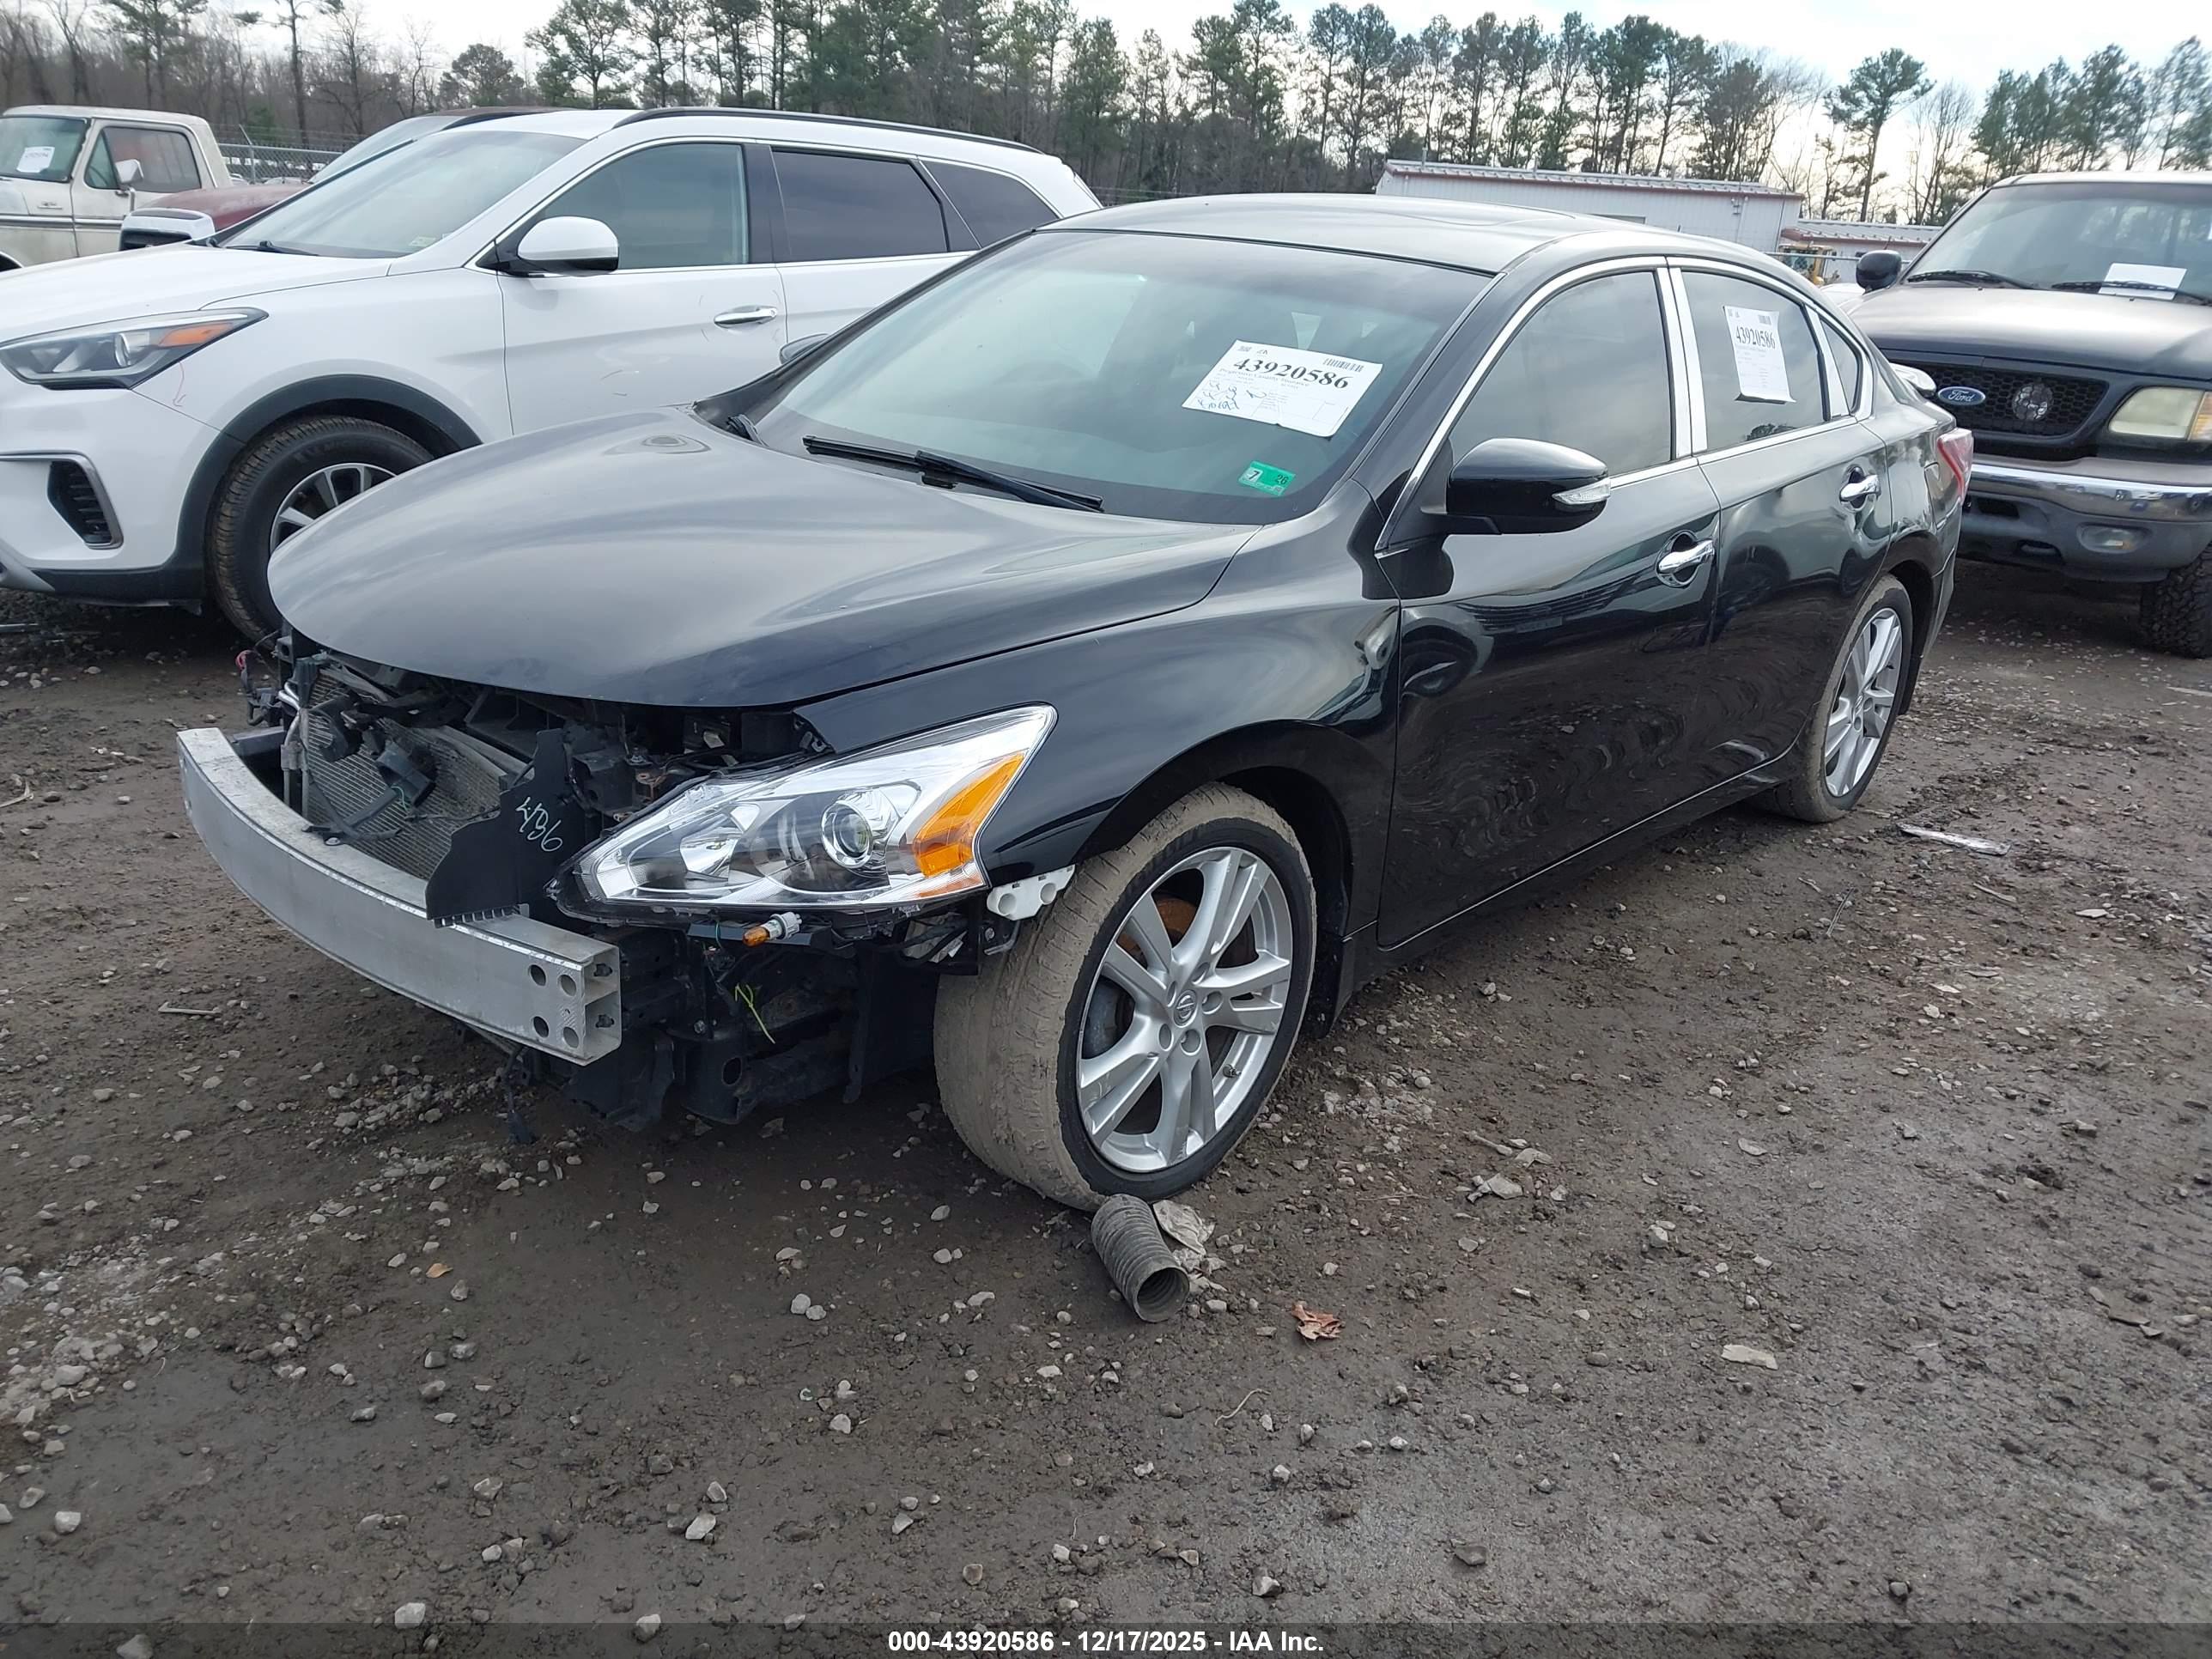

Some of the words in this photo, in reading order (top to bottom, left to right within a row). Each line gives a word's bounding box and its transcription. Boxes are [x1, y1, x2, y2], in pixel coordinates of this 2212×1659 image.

[1736, 325, 1776, 349] 43920586
[1233, 357, 1353, 389] 43920586
[1948, 389, 1975, 402] Ford
[1249, 470, 1261, 480] 7
[1275, 474, 1289, 485] 26
